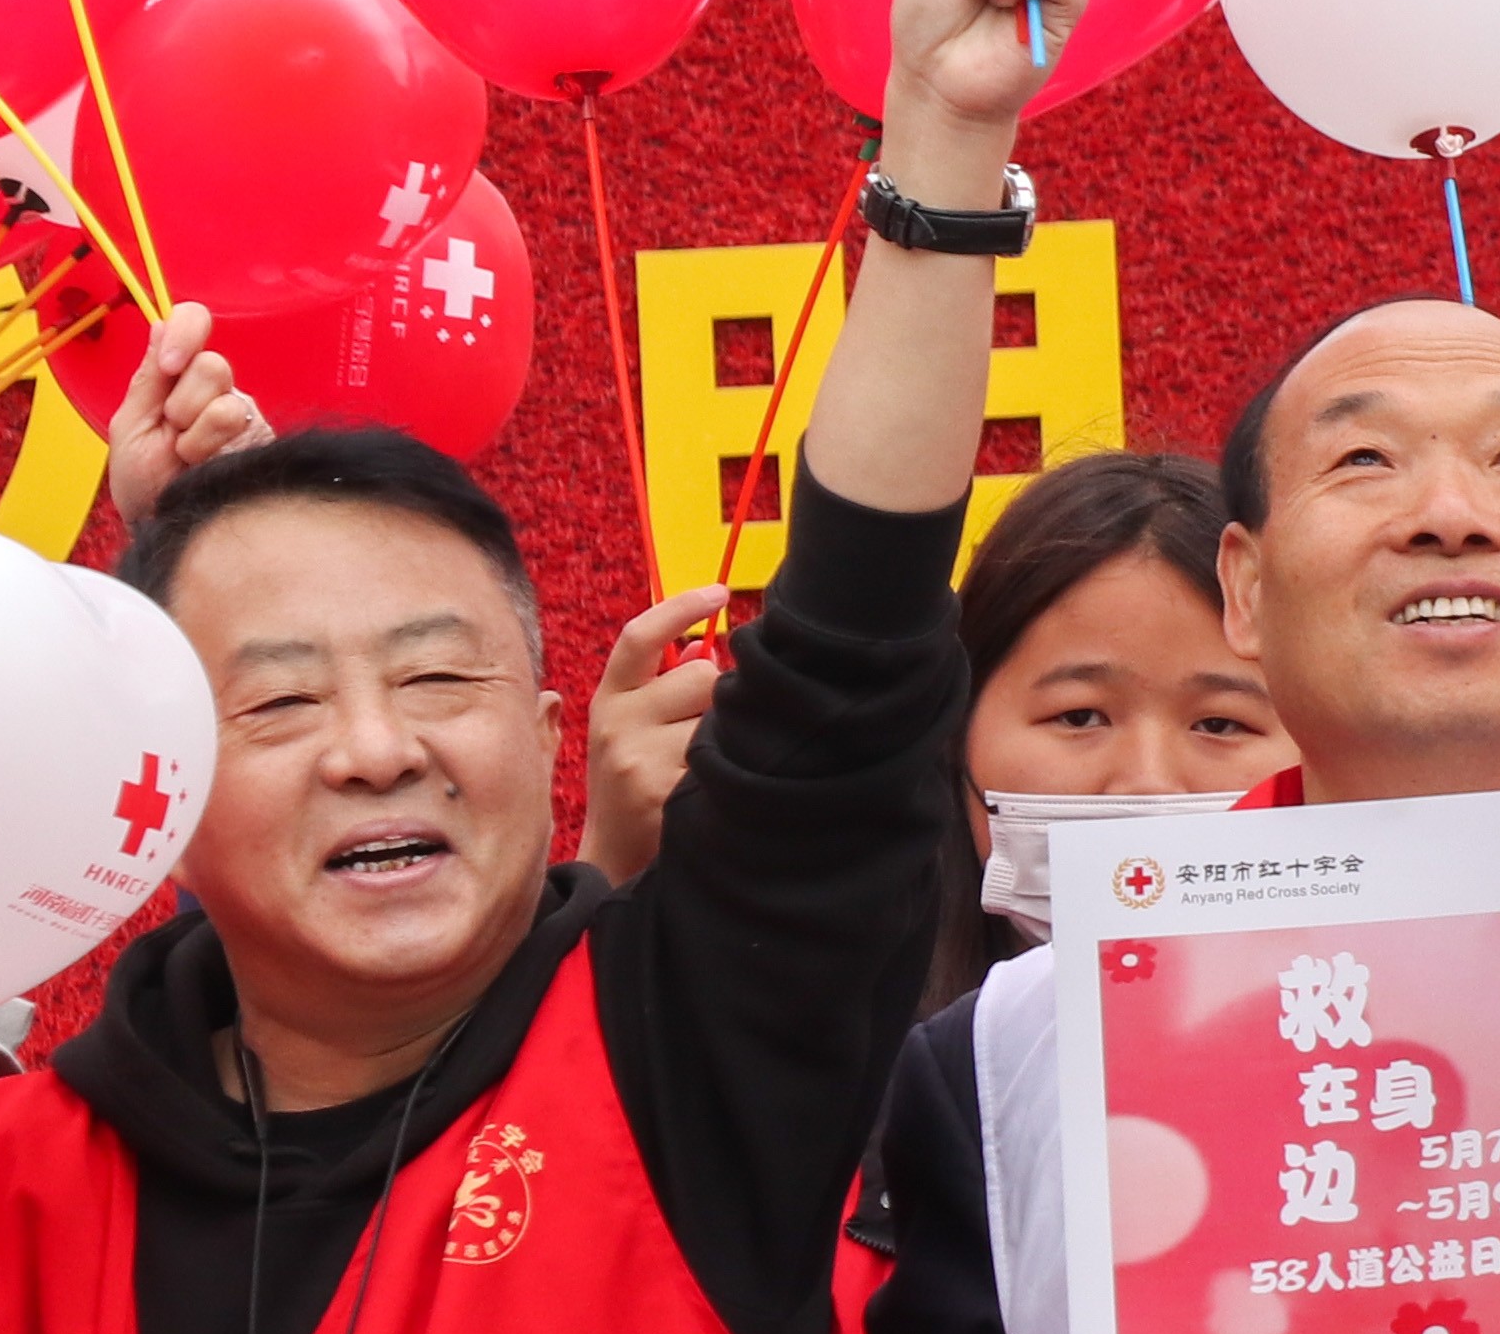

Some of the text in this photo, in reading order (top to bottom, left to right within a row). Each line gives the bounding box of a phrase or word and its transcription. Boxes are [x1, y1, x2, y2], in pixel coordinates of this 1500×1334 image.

[1176, 854, 1364, 884] 安阳市红十字会
[1181, 881, 1361, 907] Anyang Red Cross Society
[1277, 951, 1373, 1053] 救
[1299, 1060, 1436, 1132] 在身
[1278, 1139, 1359, 1227] 边
